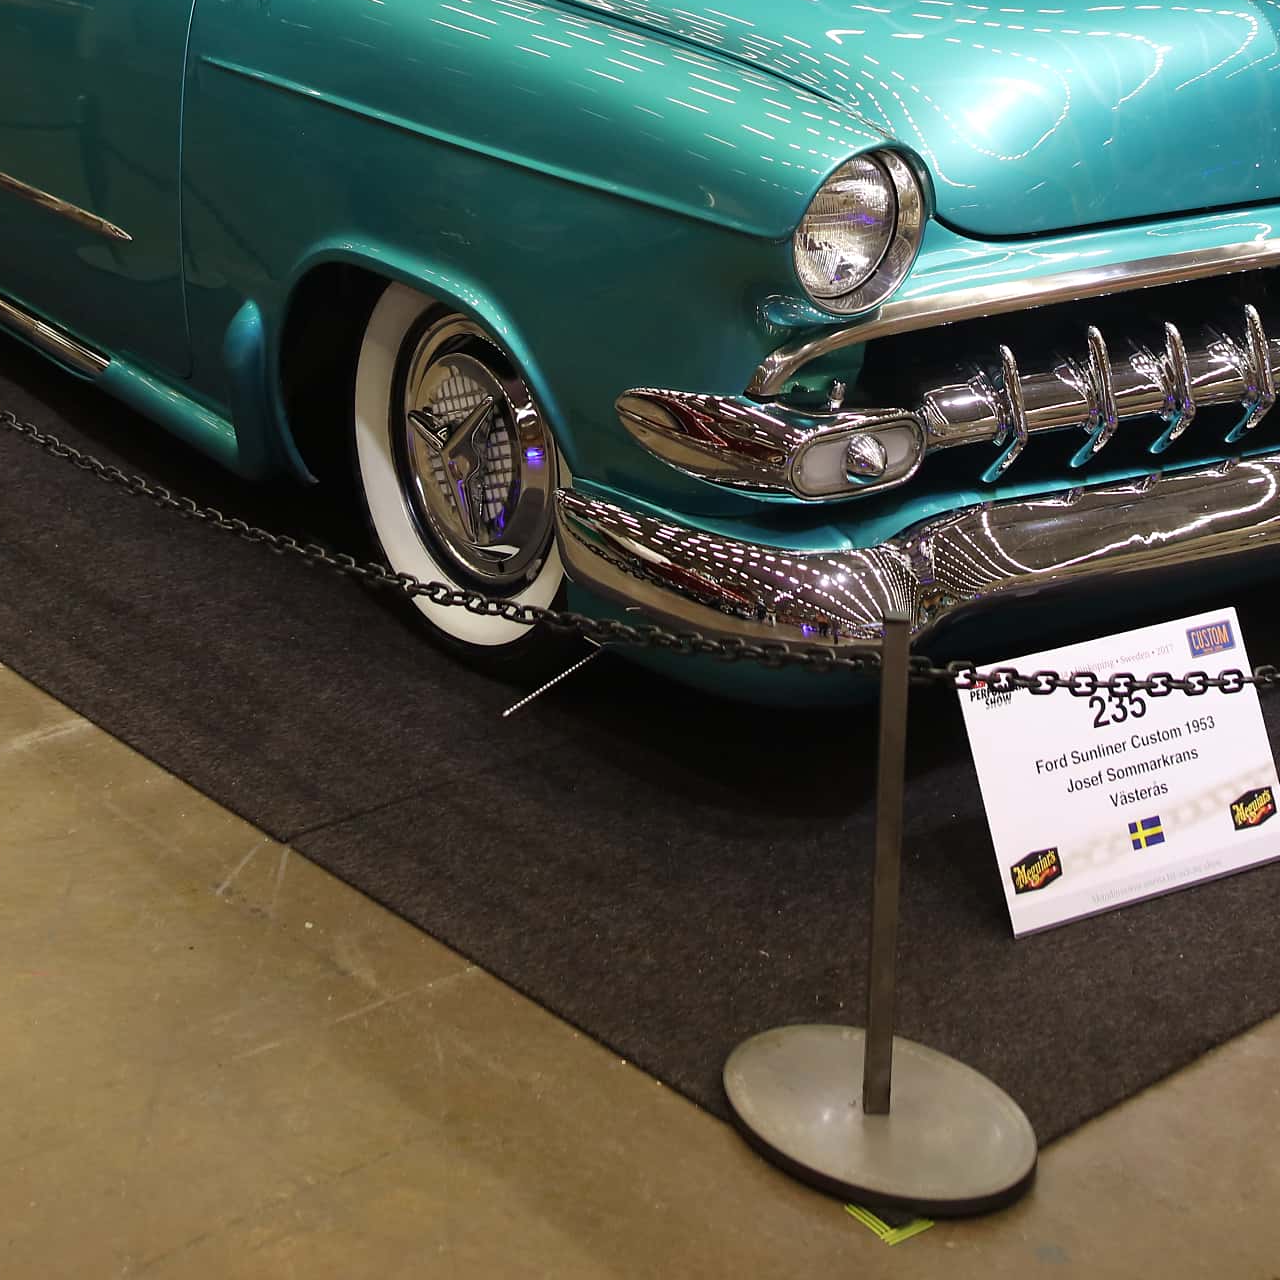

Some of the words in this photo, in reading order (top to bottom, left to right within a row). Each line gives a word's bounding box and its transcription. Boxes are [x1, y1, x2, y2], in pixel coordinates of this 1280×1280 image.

[1190, 623, 1231, 651] CUSTOM
[985, 692, 1013, 710] SHOW
[1089, 692, 1147, 728] 235
[1035, 754, 1068, 775] Ford
[1071, 740, 1127, 765] Sunliner
[1131, 727, 1182, 749] Custom
[1186, 715, 1216, 734] 1953
[1067, 771, 1104, 793] Josef
[1106, 748, 1199, 782] Sommarkrans
[1110, 781, 1169, 808] Västerås
[1230, 788, 1274, 826] Meguiar's
[1013, 849, 1057, 889] Meguiar's
